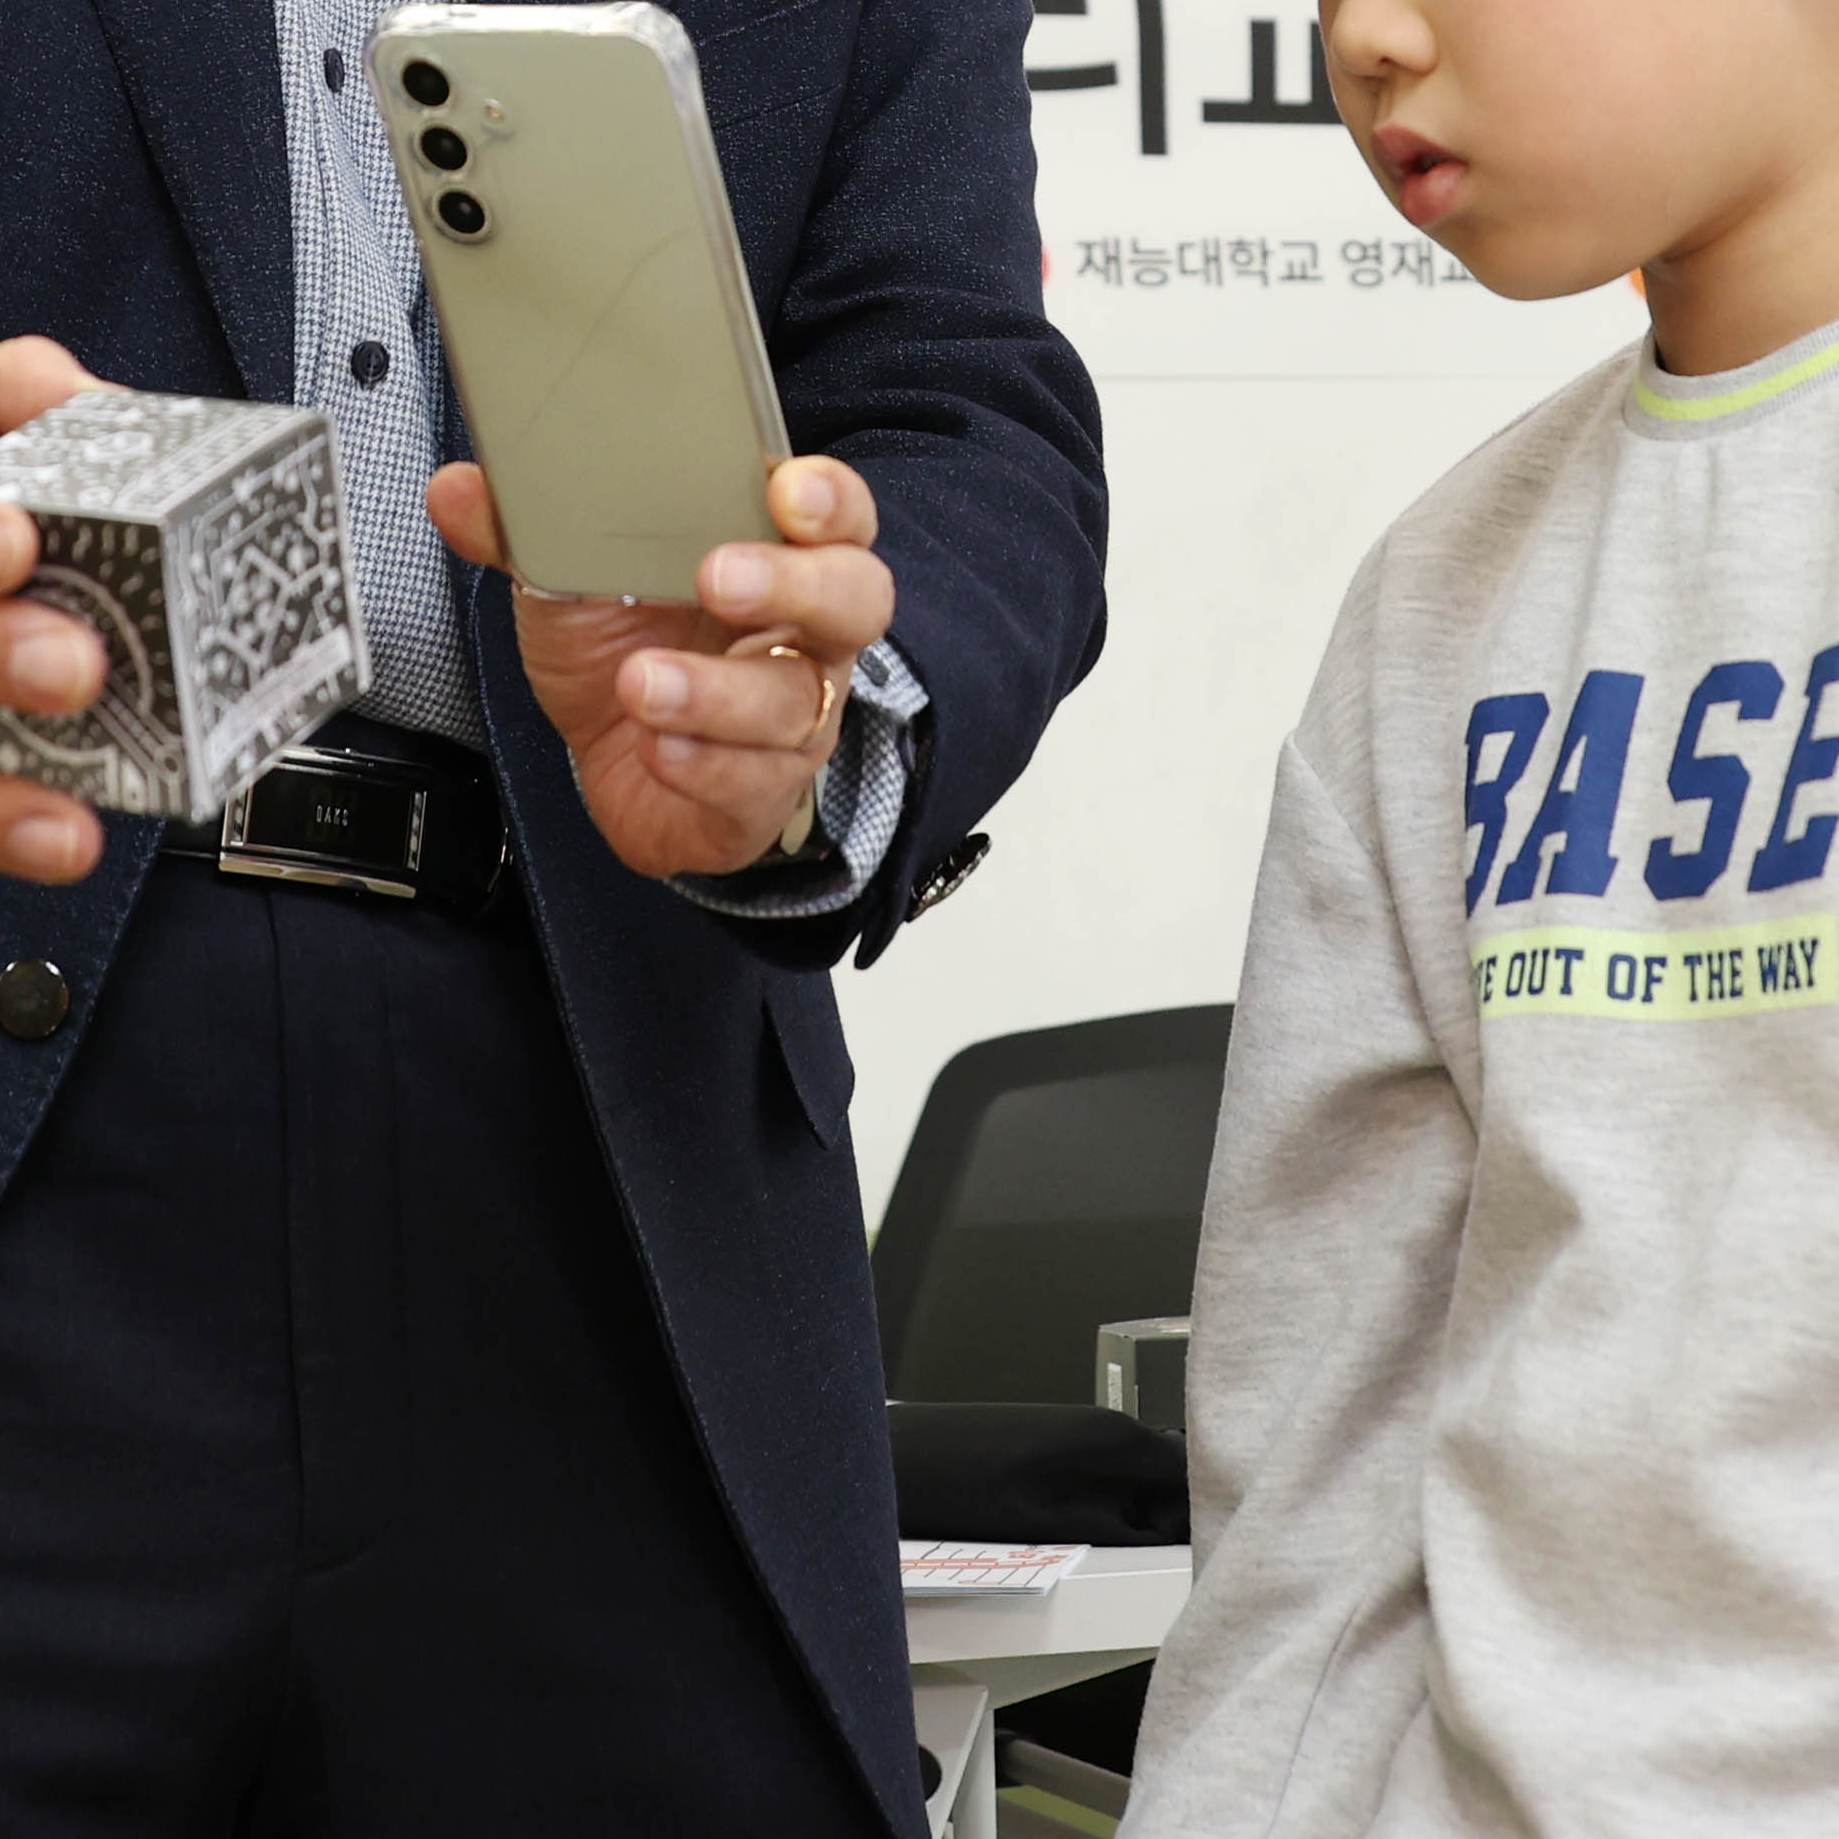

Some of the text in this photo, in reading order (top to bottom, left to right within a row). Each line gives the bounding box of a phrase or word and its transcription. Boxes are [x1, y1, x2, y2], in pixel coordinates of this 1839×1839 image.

[1075, 236, 1324, 289] 재능대학교
[1505, 948, 1584, 998] OUT
[1607, 953, 1668, 1003] OF
[1683, 949, 1743, 1003] THE
[1757, 937, 1819, 994] WAY
